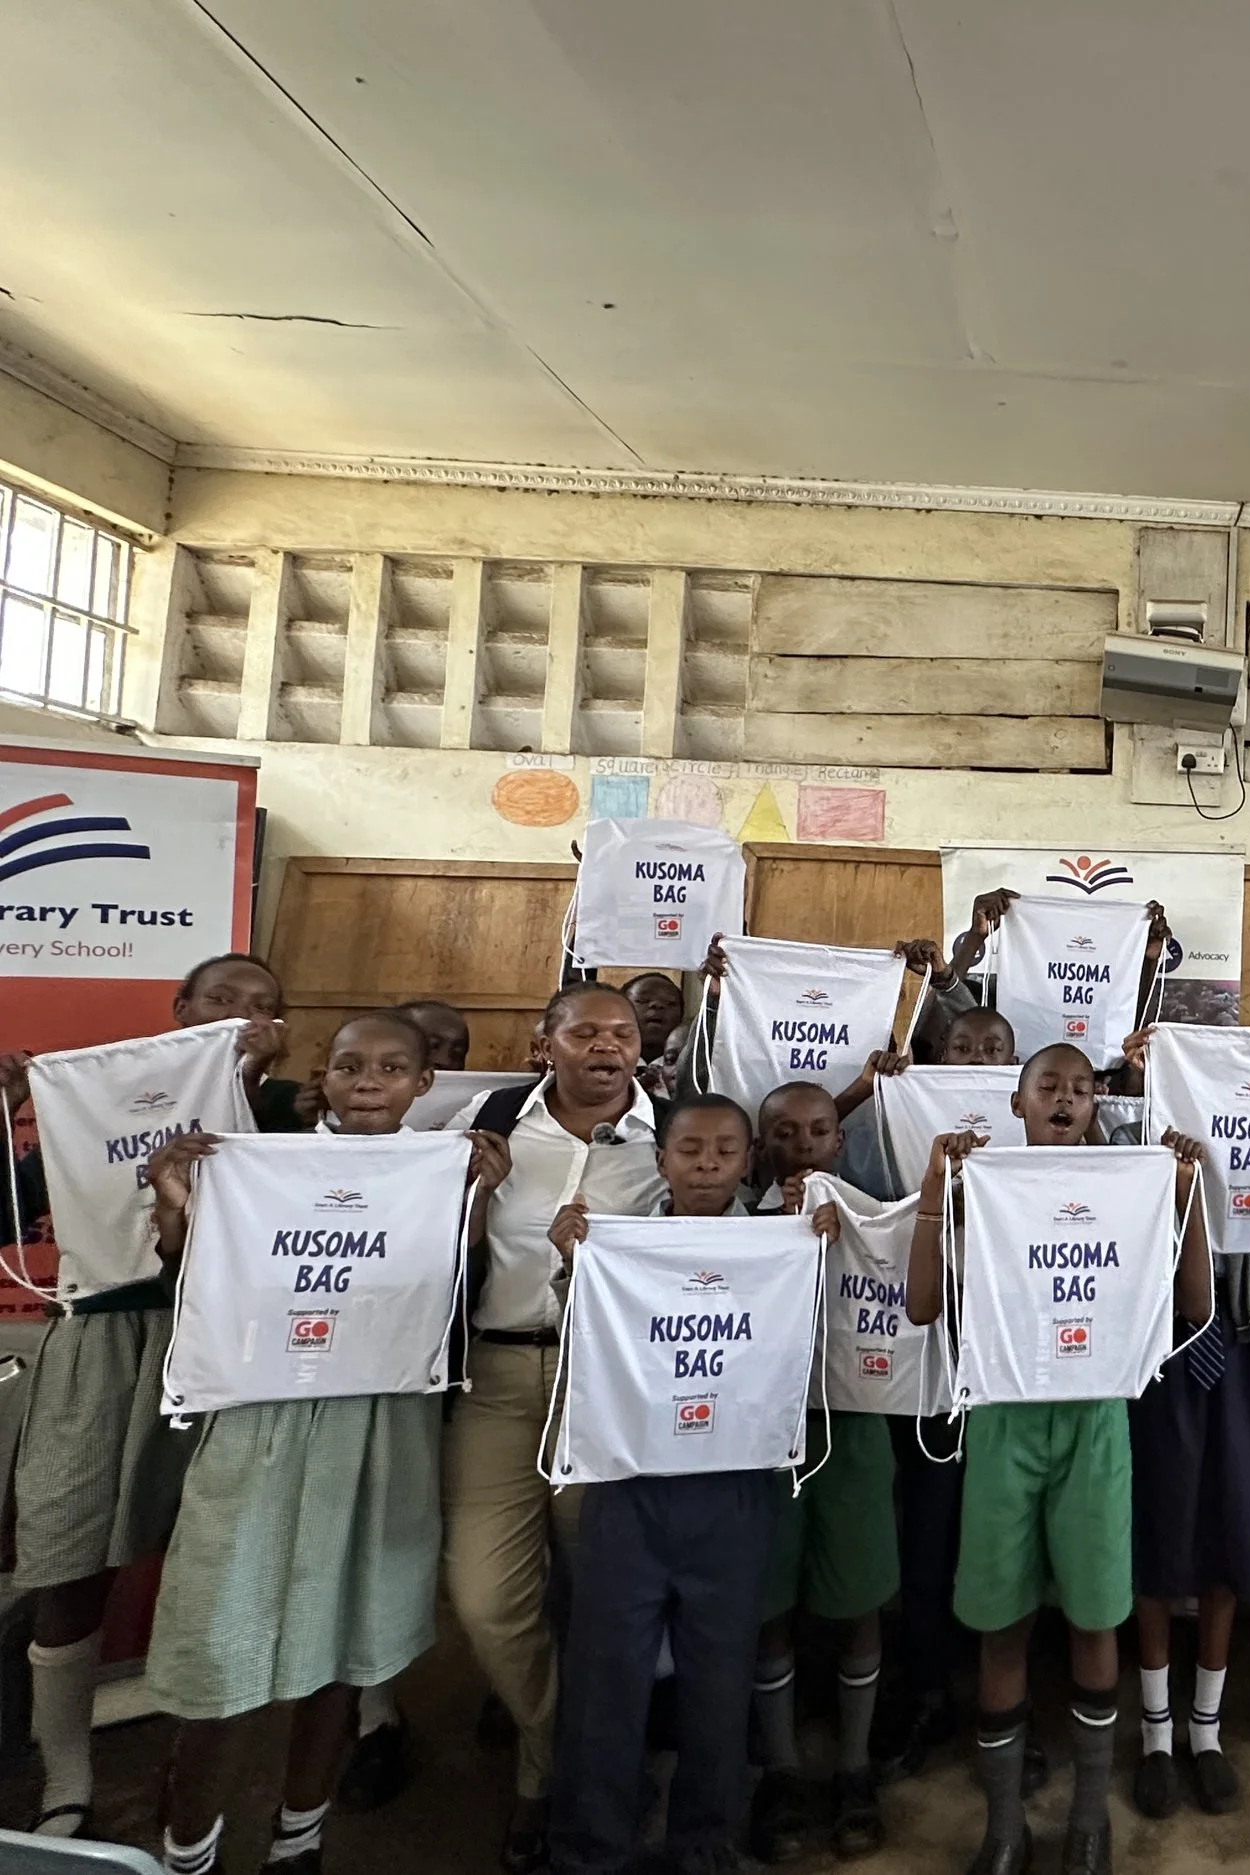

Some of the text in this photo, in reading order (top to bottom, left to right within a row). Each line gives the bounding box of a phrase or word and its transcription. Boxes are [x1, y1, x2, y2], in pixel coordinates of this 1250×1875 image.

[512, 754, 553, 767] Oval
[595, 757, 655, 776] Square
[635, 861, 705, 882] KUSOMA
[653, 884, 687, 903] BAG
[91, 903, 194, 927] Trust
[50, 940, 133, 957] School!
[1188, 951, 1230, 962] Advocacy
[1047, 961, 1111, 983] KUSOMA
[1063, 985, 1094, 1005] BAG
[771, 1020, 849, 1045] KUSOMA
[789, 1048, 827, 1071] BAG
[271, 1230, 387, 1258] KUSOMA
[1028, 1241, 1120, 1269] KUSOMA
[294, 1264, 353, 1293] BAG
[840, 1273, 905, 1307] KUSOM
[1052, 1275, 1096, 1303] BAG
[287, 1308, 329, 1317] Supported
[857, 1308, 898, 1337] BAG
[649, 1312, 752, 1342] KUSOMA
[674, 1349, 724, 1378] BAG
